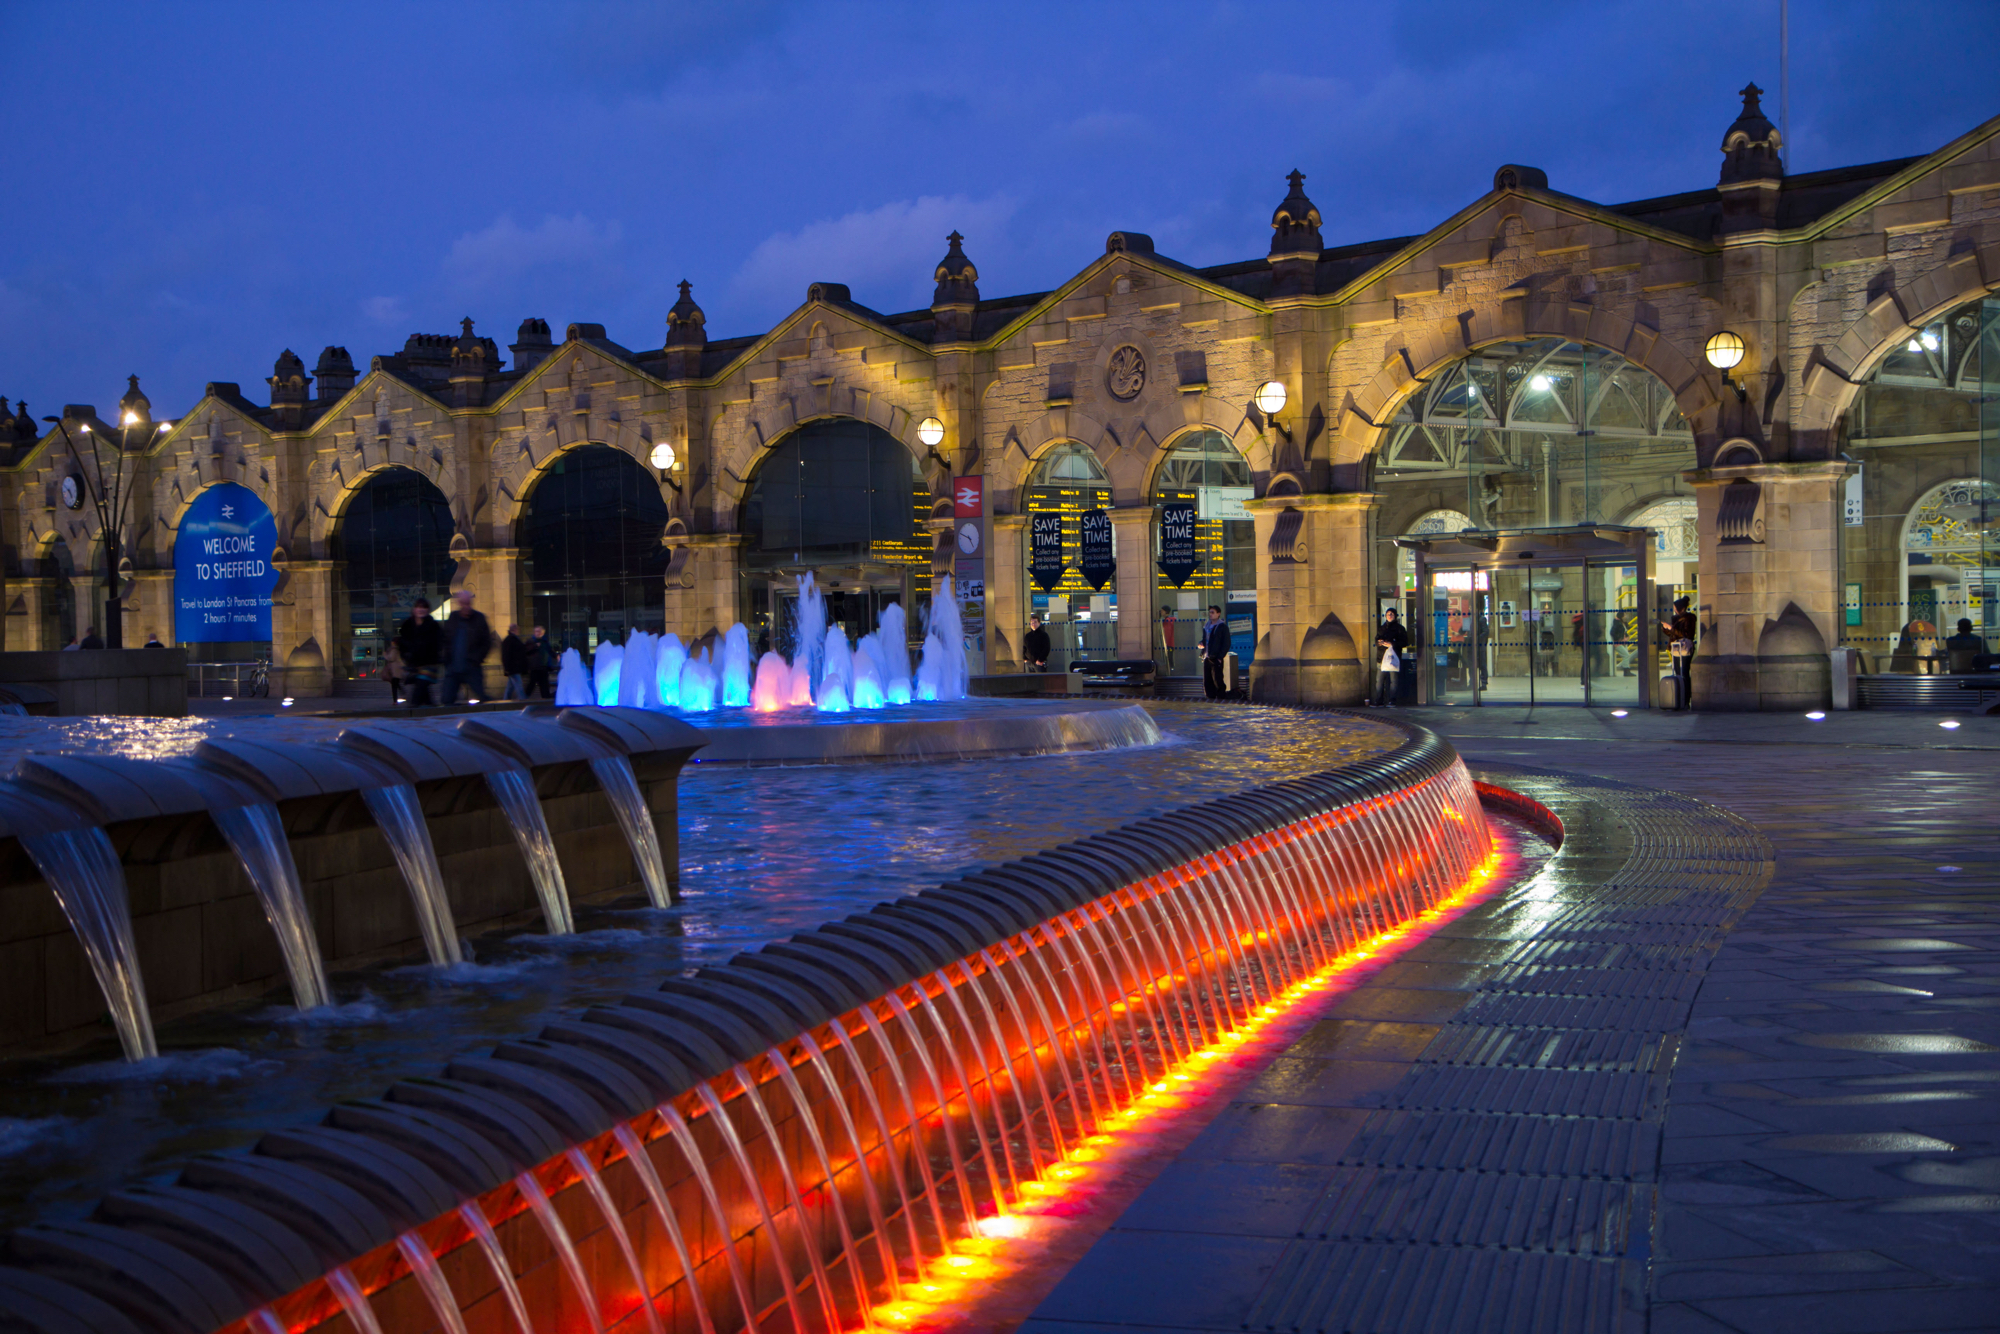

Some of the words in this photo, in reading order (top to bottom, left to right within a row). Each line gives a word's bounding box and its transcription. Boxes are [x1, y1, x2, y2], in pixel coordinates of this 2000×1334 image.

[1084, 515, 1110, 530] SAVE
[1164, 509, 1193, 524] SAVE
[1035, 518, 1060, 531] SAVE
[1035, 532, 1060, 546] TIME
[1084, 530, 1110, 544] TIME
[1165, 525, 1192, 539] TIME
[203, 535, 255, 555] WELCOME
[1085, 553, 1110, 561] pre-booked
[1165, 549, 1192, 557] pre-booked
[196, 563, 210, 580] TO
[213, 560, 265, 579] SHEFFIELD
[181, 598, 196, 609] Travel
[197, 599, 203, 608] to
[204, 597, 226, 608] London
[227, 596, 233, 607] St
[234, 596, 257, 607] Pancras
[204, 613, 208, 623] 2
[210, 612, 226, 623] hours
[228, 612, 232, 622] 7
[233, 612, 257, 622] minutes
